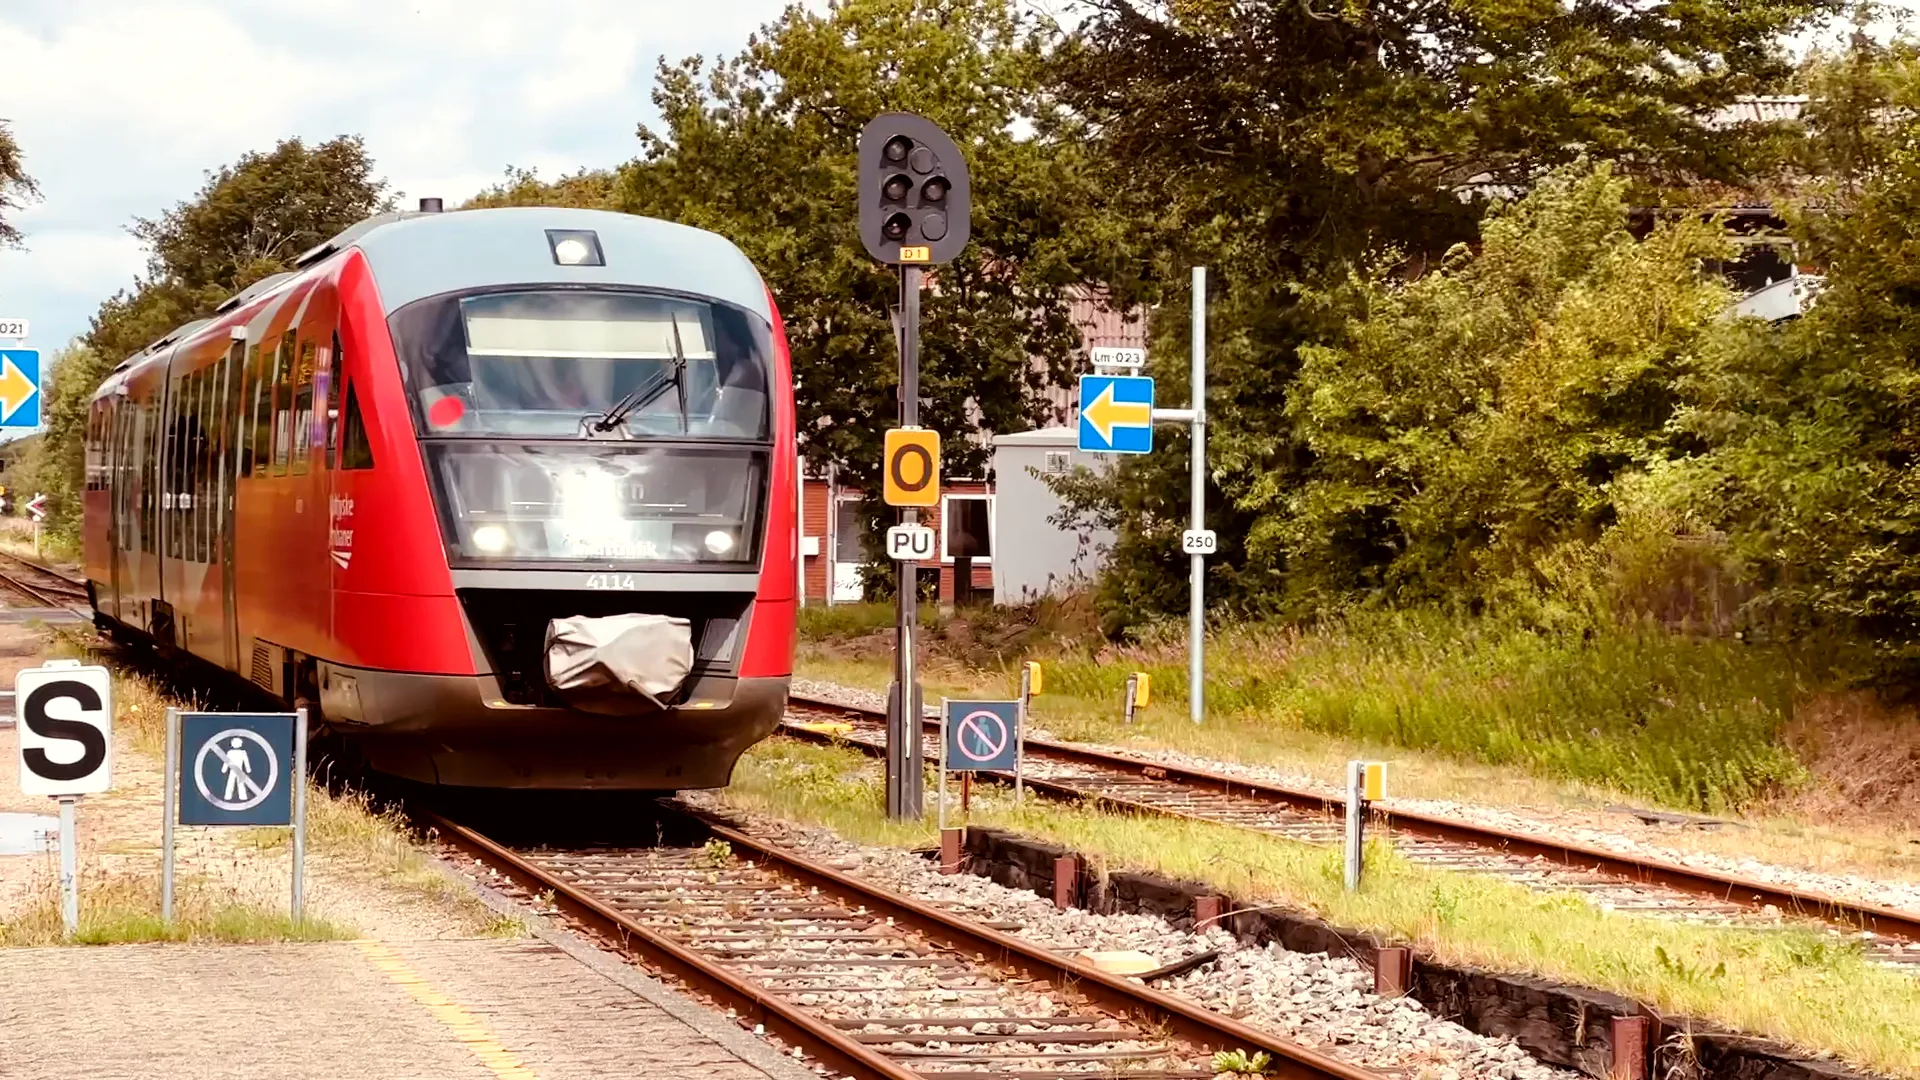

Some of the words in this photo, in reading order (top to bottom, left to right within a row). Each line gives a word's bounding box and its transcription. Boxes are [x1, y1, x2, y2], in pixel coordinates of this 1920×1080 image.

[1094, 351, 1140, 363] Lm-023
[894, 532, 929, 554] PU
[1186, 536, 1214, 548] 250
[585, 574, 635, 590] 4114
[22, 680, 106, 781] S
